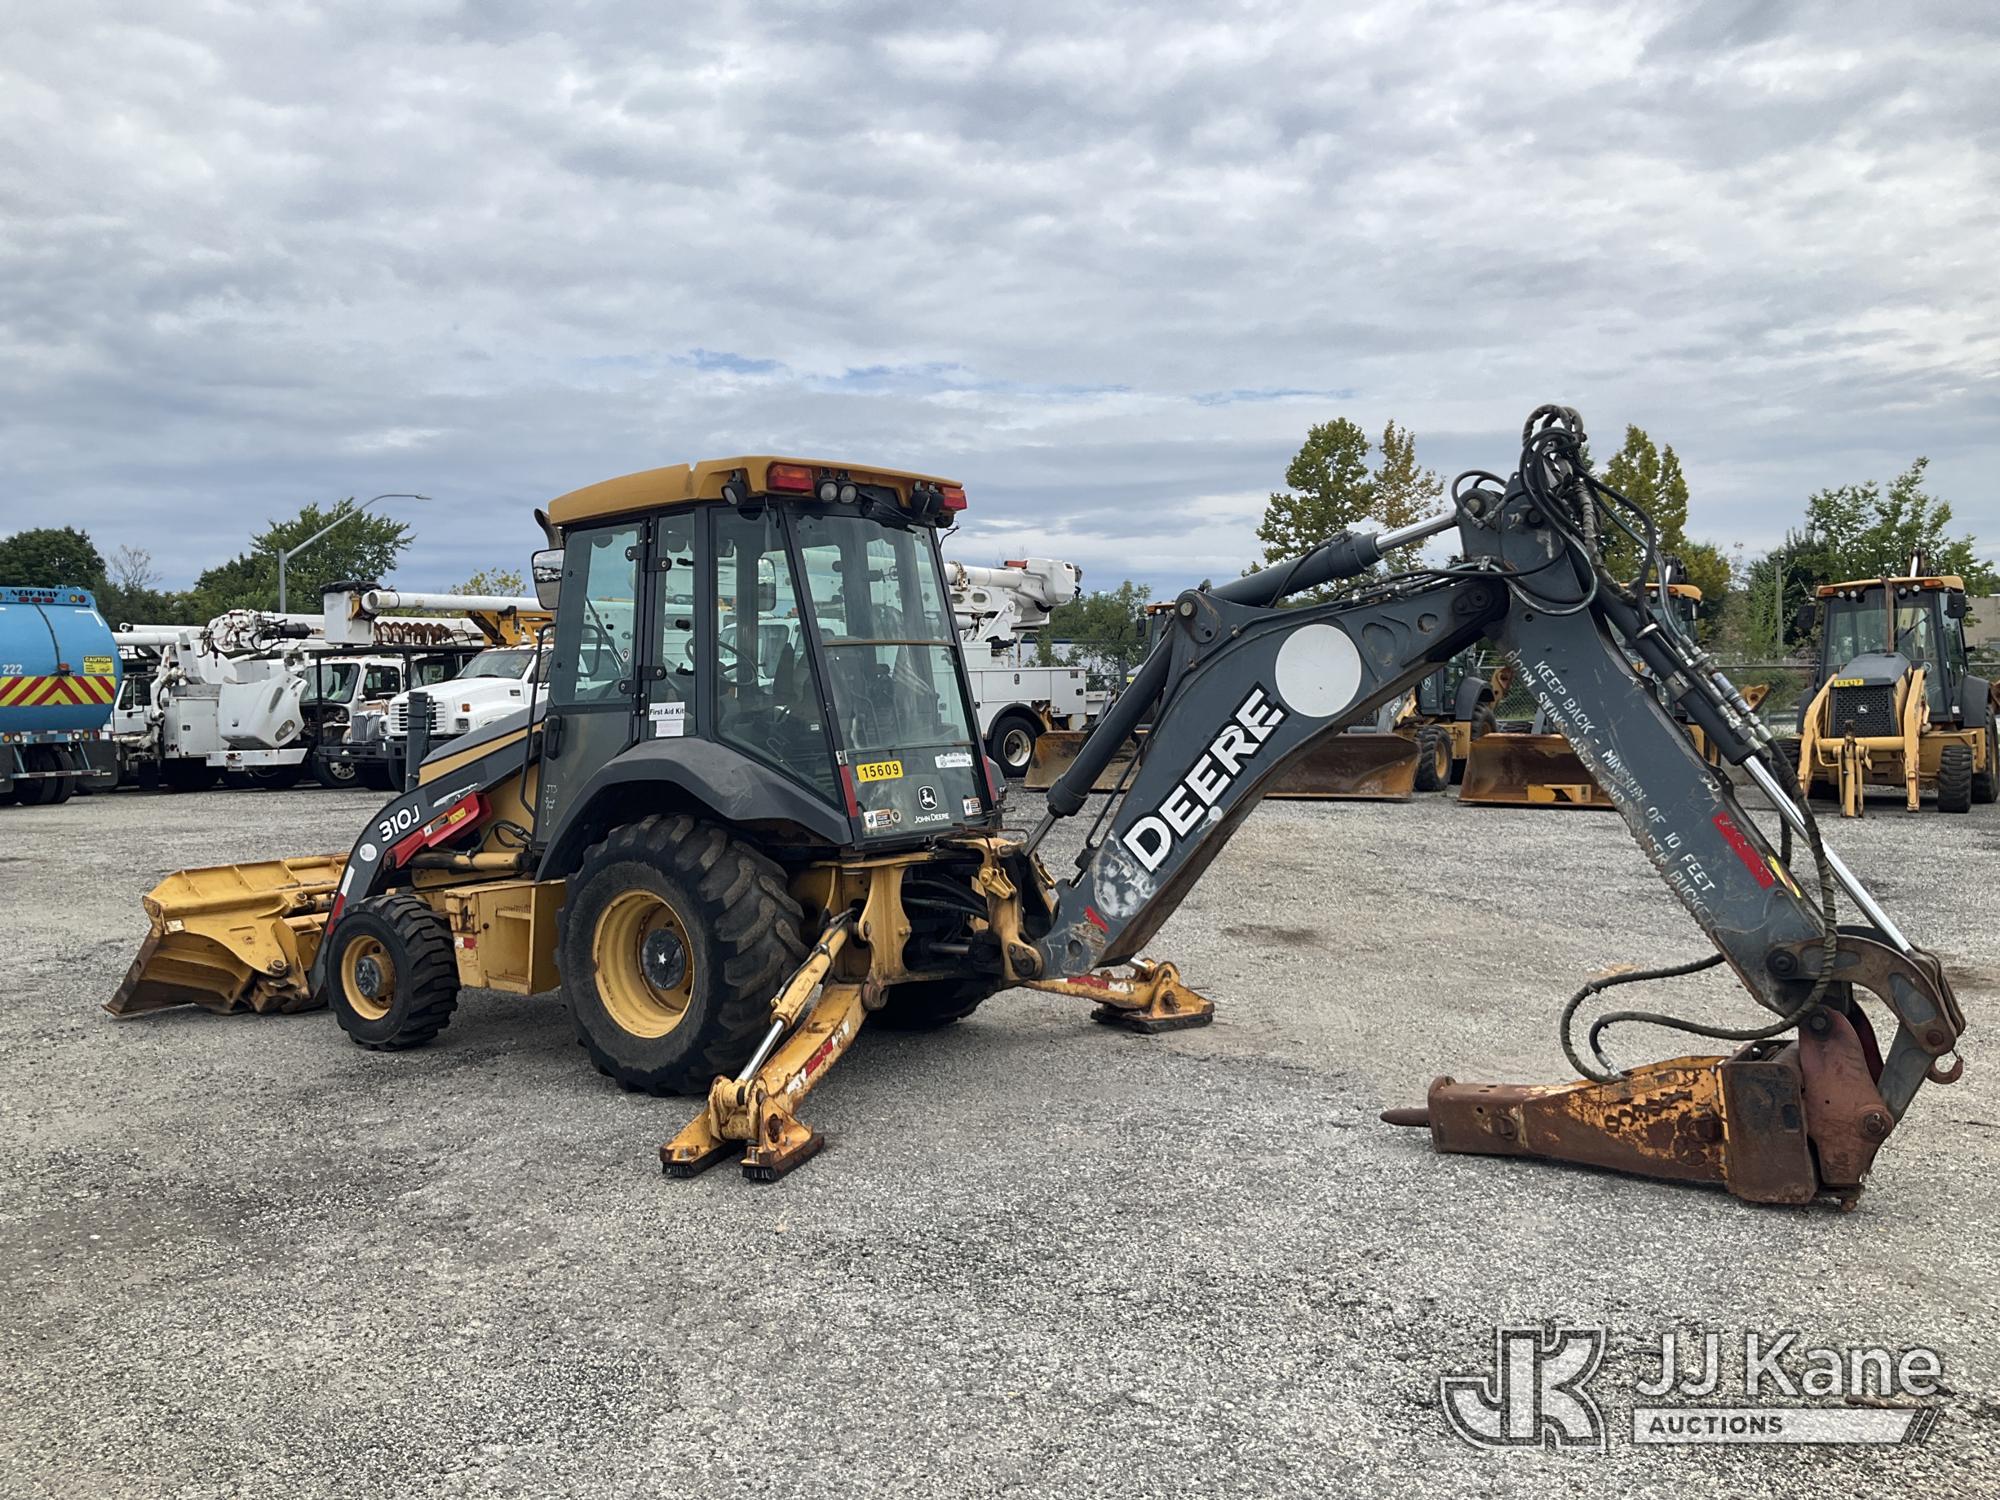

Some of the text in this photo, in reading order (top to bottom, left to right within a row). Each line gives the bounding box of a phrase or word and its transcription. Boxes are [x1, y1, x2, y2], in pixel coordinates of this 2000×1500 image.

[2, 664, 22, 675] 222
[863, 763, 899, 778] 15609
[1122, 688, 1284, 873] DEERE
[1534, 660, 1567, 695] KEEP
[1563, 698, 1596, 735] BACK
[1602, 749, 1647, 801] MINUM
[1646, 806, 1666, 823] OF
[1664, 832, 1681, 849] 10
[1680, 853, 1715, 891] FEET
[379, 805, 420, 842] 310J
[914, 812, 950, 824] JOHN DEERE
